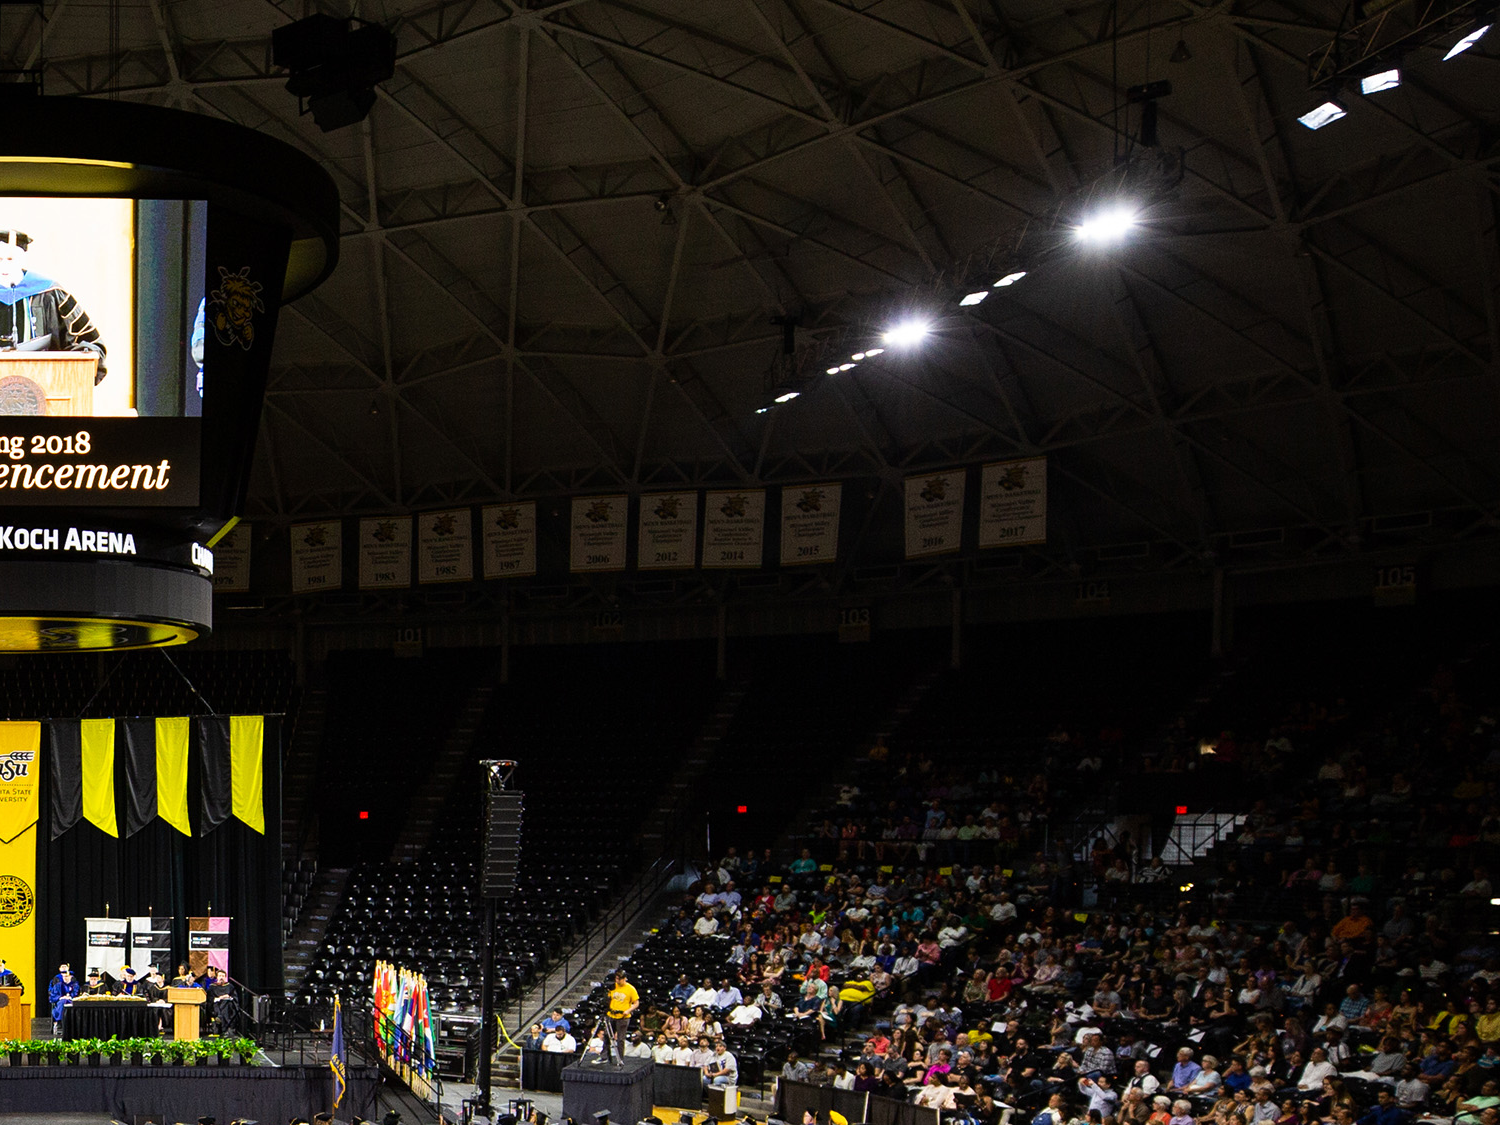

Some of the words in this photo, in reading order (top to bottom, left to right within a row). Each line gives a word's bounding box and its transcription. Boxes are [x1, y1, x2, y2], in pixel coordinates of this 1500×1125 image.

[30, 431, 91, 454] 2018
[999, 525, 1026, 538] 2017
[65, 527, 136, 555] ARENA
[922, 536, 945, 549] 2016
[655, 551, 678, 562] 2012
[720, 551, 744, 561] 2014
[797, 545, 820, 557] 2015
[500, 559, 520, 571] 1987
[586, 554, 610, 565] 2006
[435, 565, 457, 576] 1985
[214, 576, 234, 585] 1976
[307, 575, 326, 585] 1981
[375, 572, 397, 582] 1983
[1377, 566, 1416, 588] 105
[841, 609, 870, 626] 103
[397, 628, 422, 643] 101
